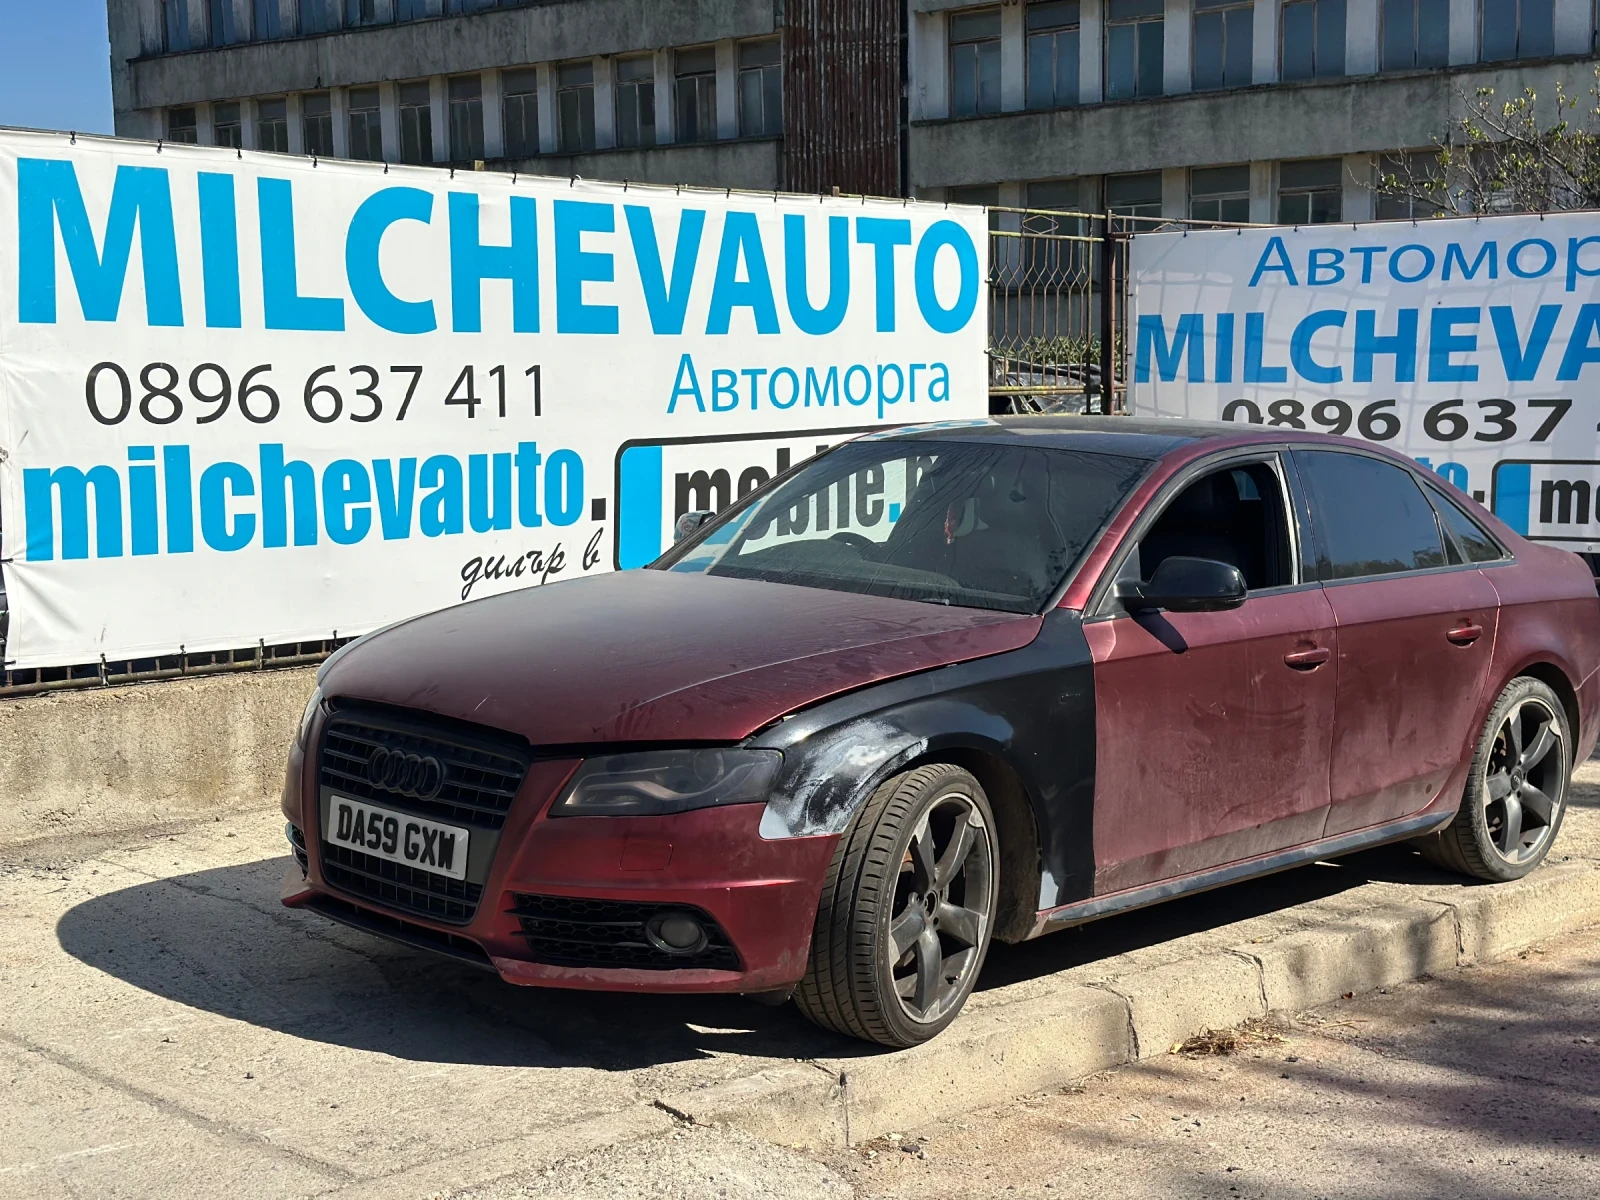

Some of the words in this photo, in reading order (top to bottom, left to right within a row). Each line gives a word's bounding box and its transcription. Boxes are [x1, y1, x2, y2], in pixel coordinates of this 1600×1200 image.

[17, 157, 979, 336] MILCHEVAUTO
[85, 361, 280, 425] 0896
[303, 364, 423, 423] 637
[444, 363, 543, 418] 411
[667, 353, 950, 419] Автоморга
[1423, 398, 1573, 442] 637
[460, 542, 567, 601] дилър
[582, 527, 604, 571] в
[335, 802, 399, 856] DA59
[402, 816, 456, 871] GXW
